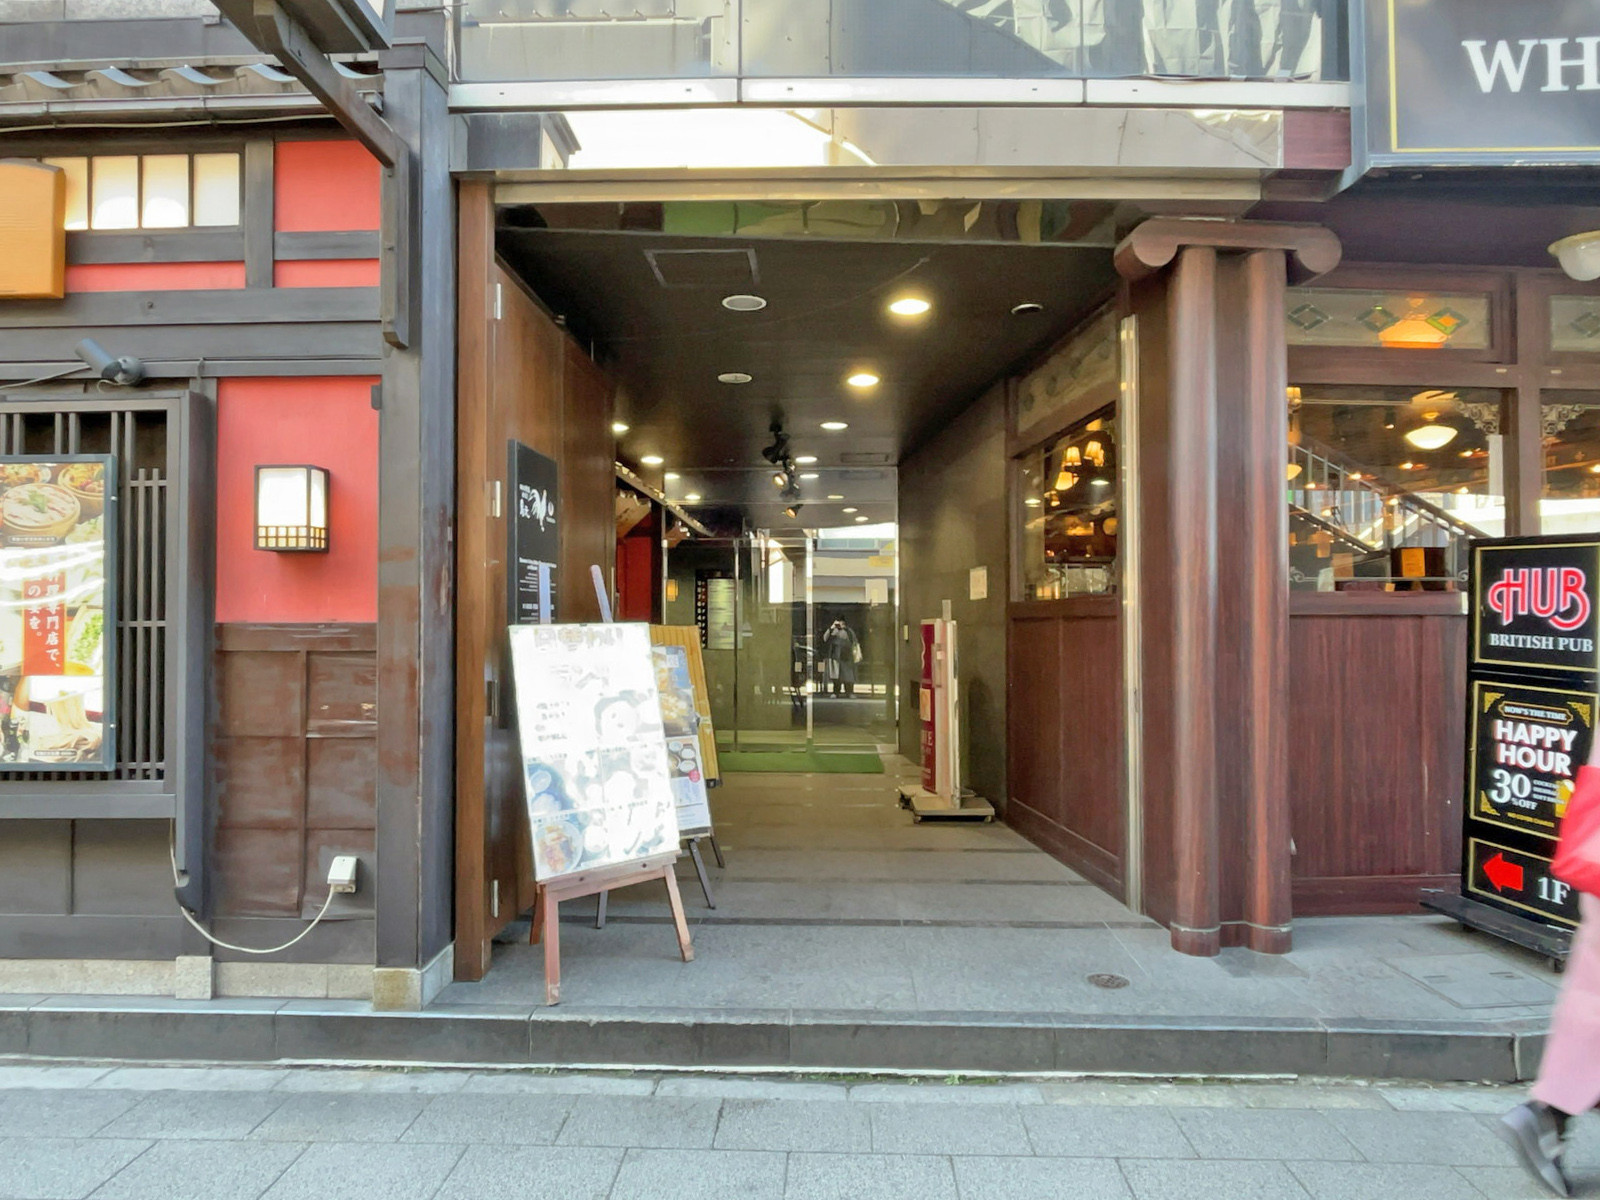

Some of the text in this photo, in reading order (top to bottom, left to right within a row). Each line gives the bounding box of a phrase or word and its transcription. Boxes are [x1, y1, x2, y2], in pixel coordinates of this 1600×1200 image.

[1461, 36, 1600, 93] WH
[1488, 567, 1590, 631] HUB
[1489, 633, 1593, 653] BRITISH PUB
[1494, 719, 1578, 751] HAPPY
[1497, 743, 1572, 777] HOUR
[1490, 768, 1532, 804] 30
[1511, 797, 1538, 810] %OFF
[1537, 876, 1571, 906] 1F
